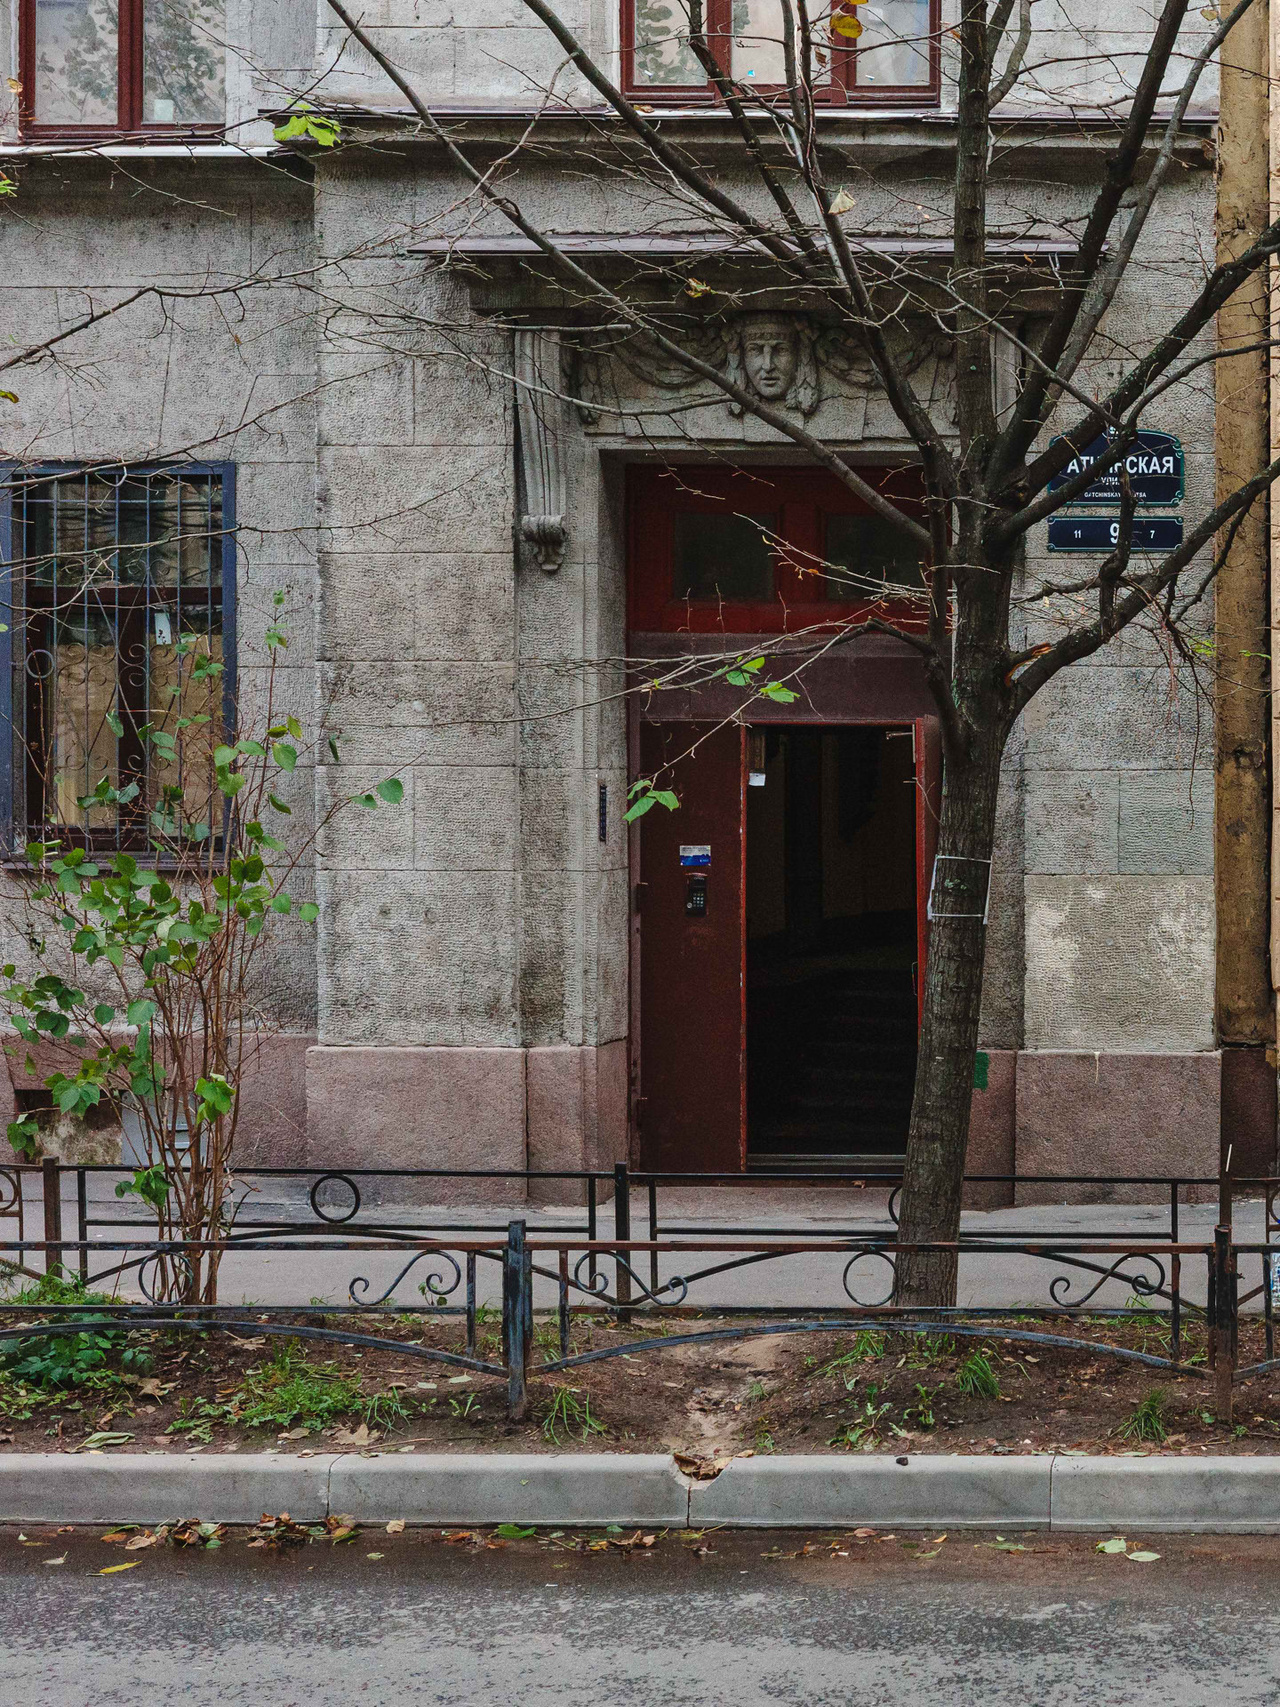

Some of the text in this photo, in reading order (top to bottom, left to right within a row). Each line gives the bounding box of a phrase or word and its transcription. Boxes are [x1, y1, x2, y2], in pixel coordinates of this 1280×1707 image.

[1073, 522, 1155, 544] 11 9 7
